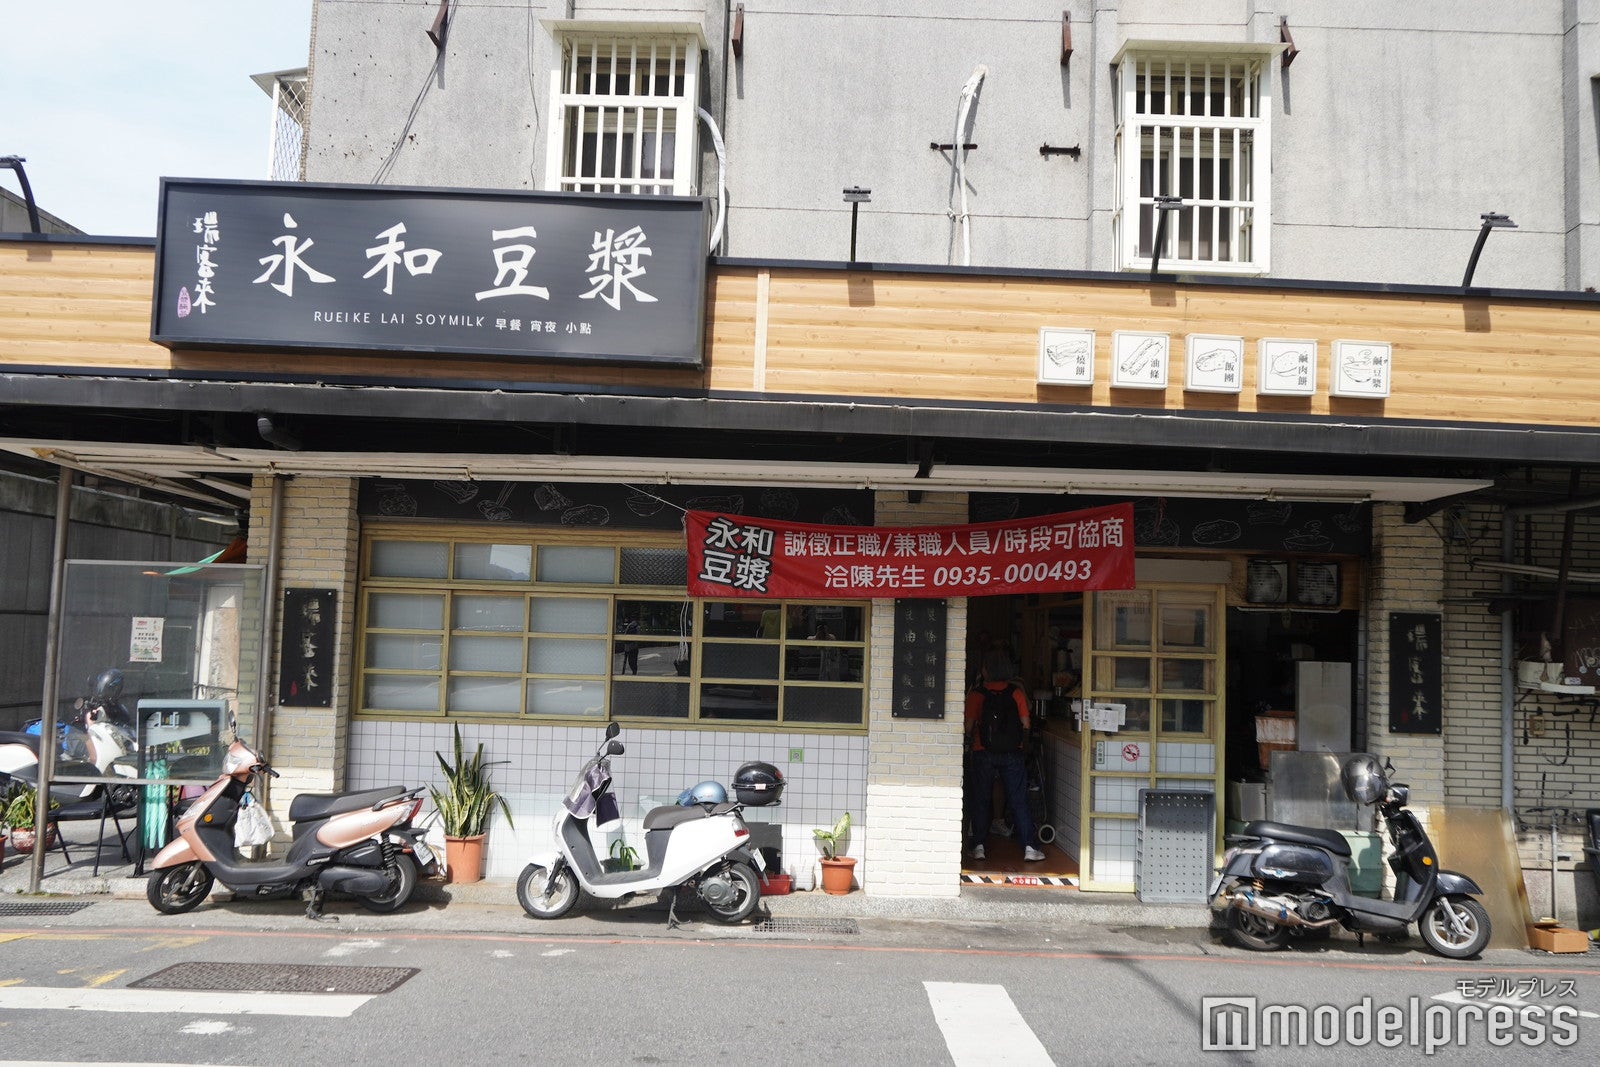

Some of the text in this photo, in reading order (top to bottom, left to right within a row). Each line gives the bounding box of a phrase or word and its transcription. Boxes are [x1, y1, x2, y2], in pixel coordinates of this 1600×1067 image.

[252, 212, 659, 312] 永和豆漿
[314, 311, 486, 327] RUEIKE LAI SOYMILK
[495, 318, 592, 334] 早餐 宵夜 小點
[705, 517, 774, 556] 永和
[700, 549, 771, 592] 豆漿
[824, 559, 1092, 588] 洽陳先生 0935-000493
